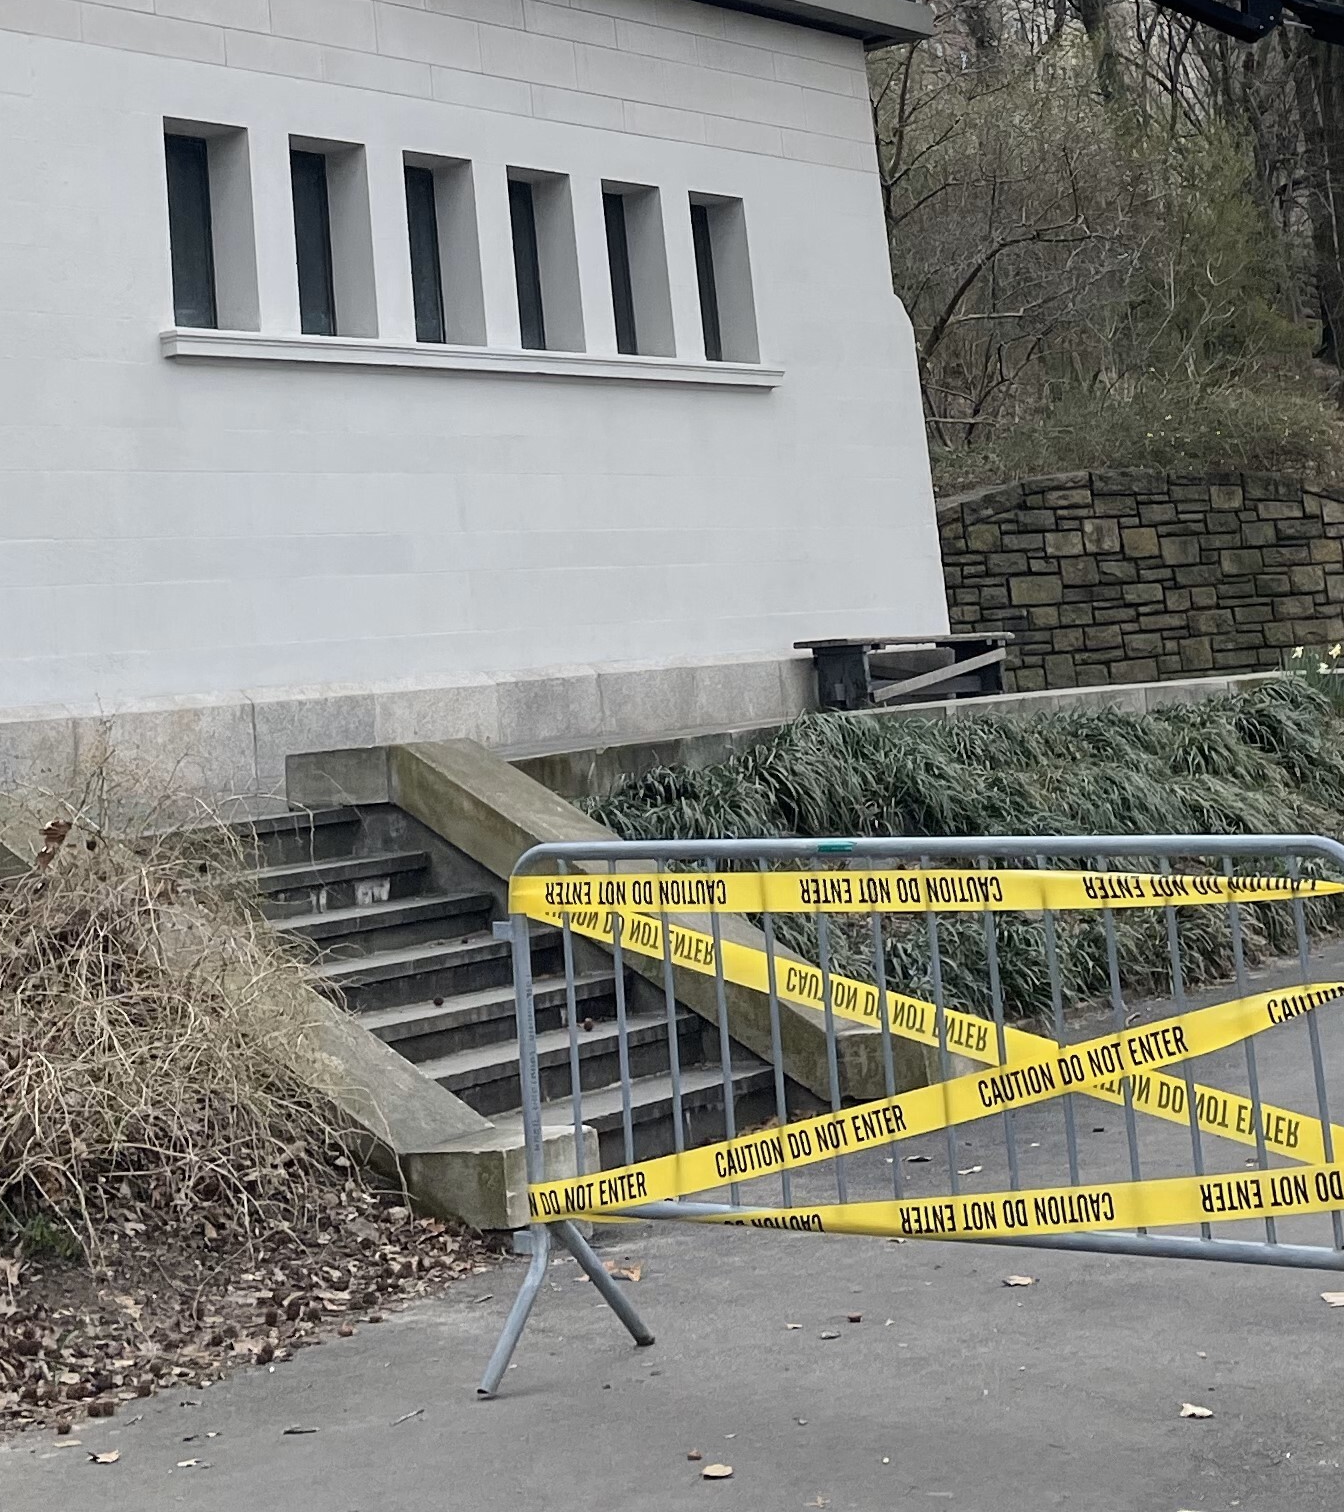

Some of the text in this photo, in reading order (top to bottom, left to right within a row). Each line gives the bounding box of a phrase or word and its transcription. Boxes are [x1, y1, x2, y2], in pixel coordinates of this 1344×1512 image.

[546, 879, 727, 905] CAUTION DO NOT ENTER
[800, 876, 1003, 904] CAUTION DO NOT ENTER
[1083, 875, 1146, 899] ENTER
[1150, 875, 1189, 897] NOT
[978, 1026, 1189, 1108] CAUTION DO NOT ENTER
[715, 1104, 907, 1178] CAUTION DO NOT ENTER
[539, 1190, 560, 1215] DO
[564, 1183, 594, 1213] NOT
[599, 1172, 647, 1206] ENTER
[1200, 1179, 1264, 1213] ENTER
[1270, 1174, 1310, 1207] NOT
[1314, 1170, 1344, 1203] DO
[899, 1192, 1115, 1235] CAUTION DO NOT ENTER
